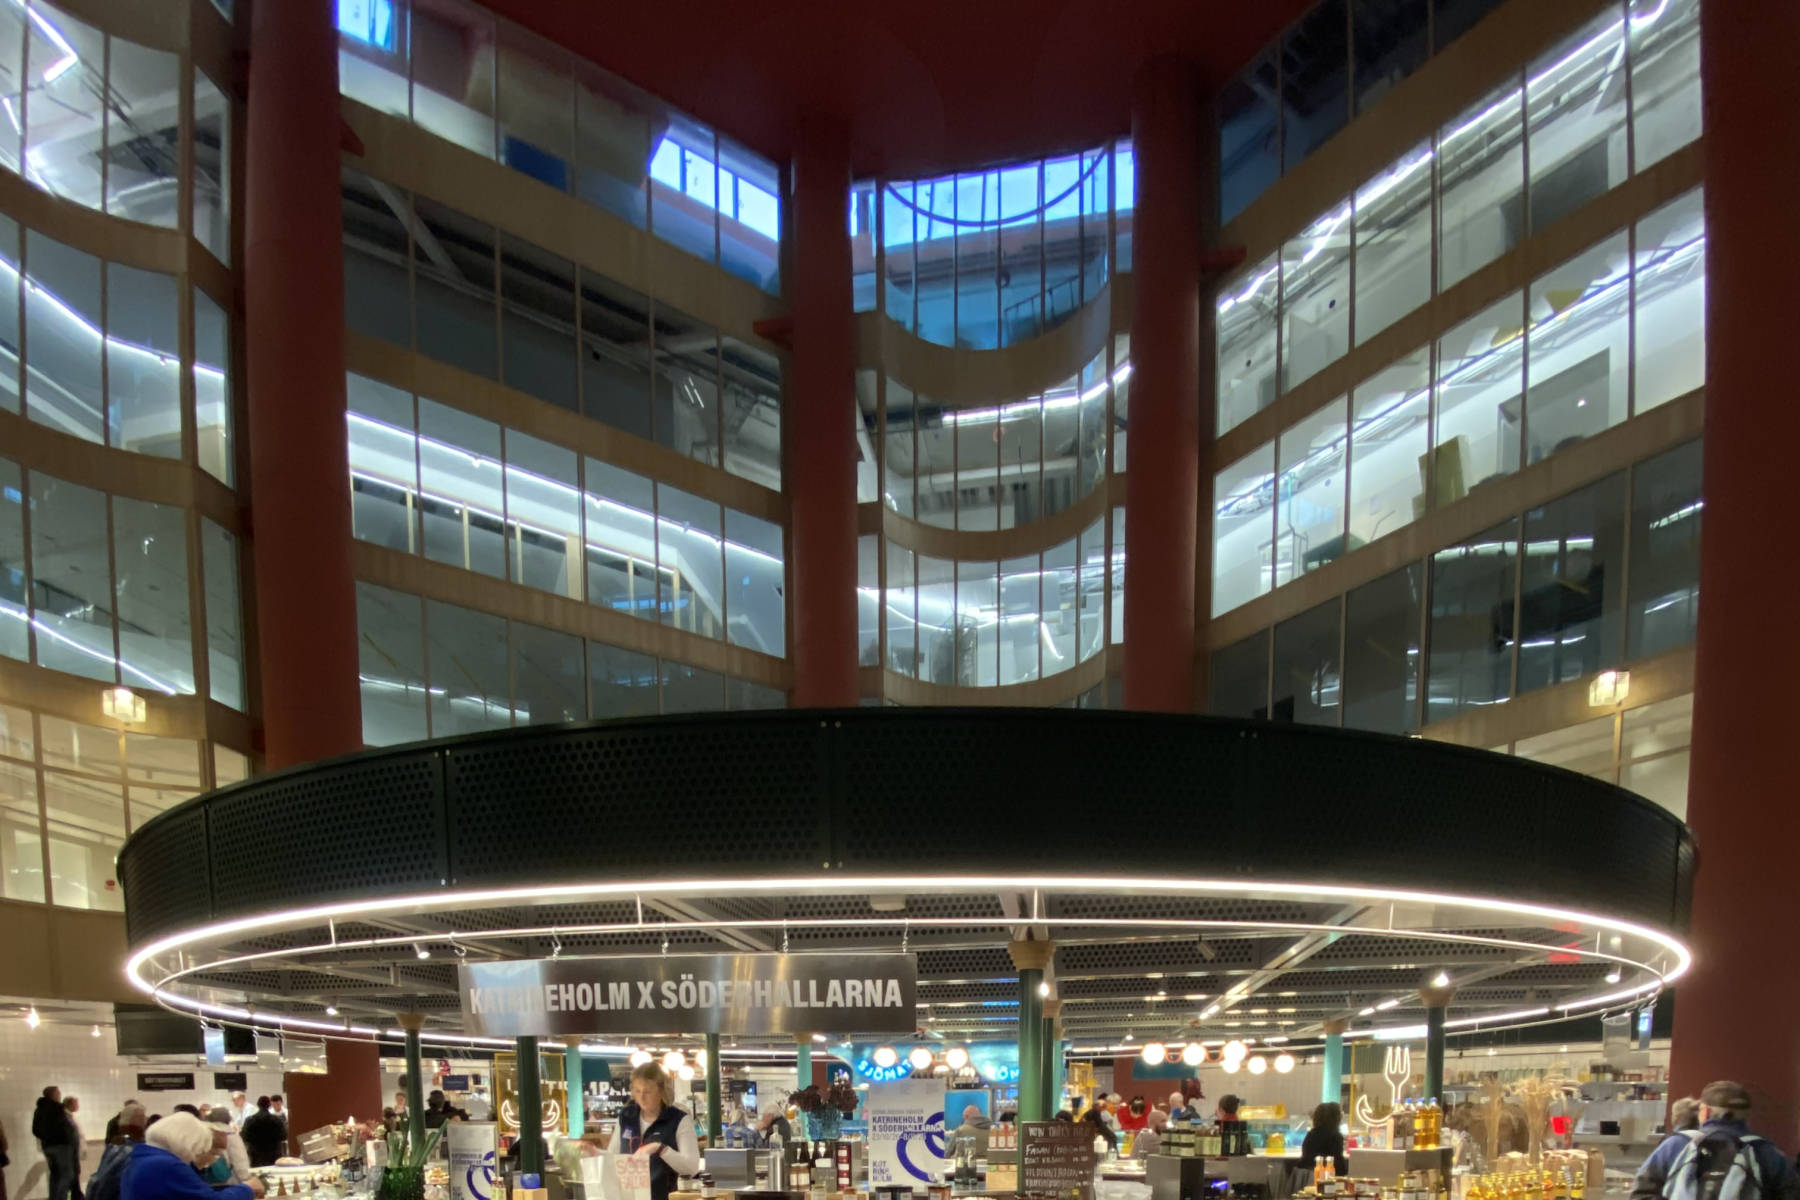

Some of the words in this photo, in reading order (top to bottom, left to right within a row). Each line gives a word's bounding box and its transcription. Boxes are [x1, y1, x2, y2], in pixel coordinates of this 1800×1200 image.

[470, 982, 631, 1014] KATRINEHOLM
[637, 981, 656, 1009] X
[661, 973, 903, 1010] SÖDERHALLARNA
